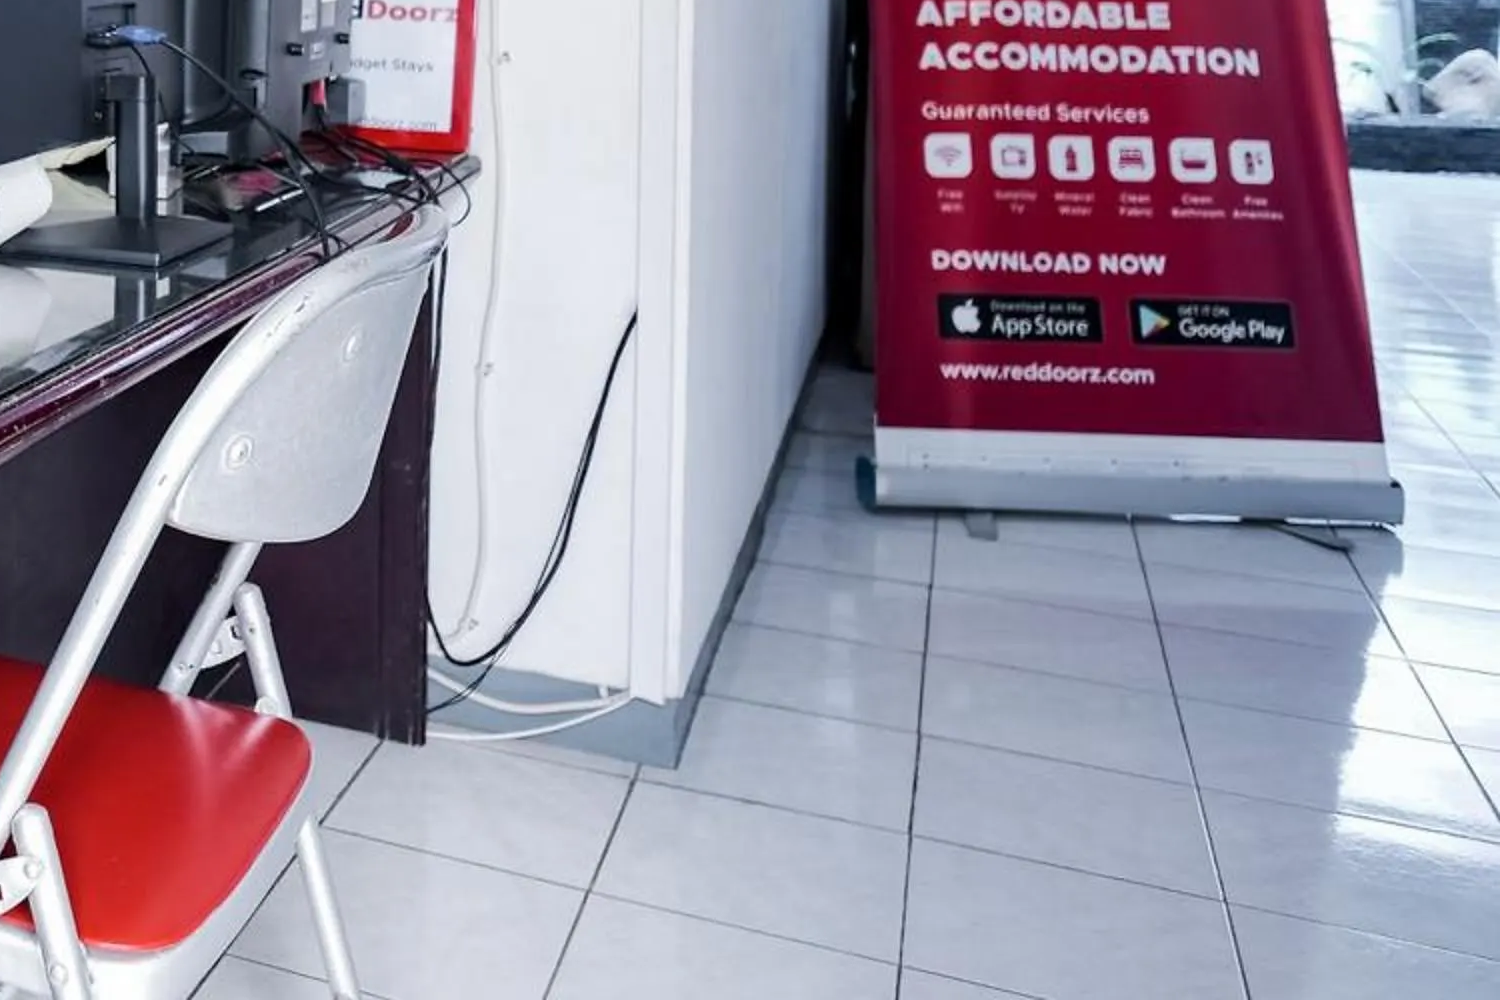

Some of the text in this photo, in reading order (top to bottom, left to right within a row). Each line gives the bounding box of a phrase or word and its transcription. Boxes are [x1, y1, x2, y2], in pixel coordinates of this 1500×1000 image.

[392, 58, 435, 74] Stays
[918, 41, 1261, 78] ACCOMMODATION
[921, 101, 1151, 124] Guaranteed Services
[931, 250, 1167, 276] DOWNLOAD NOW
[991, 314, 1090, 340] App Store
[1178, 317, 1285, 345] Google Play
[939, 361, 1156, 385] www.reddoorz.com
